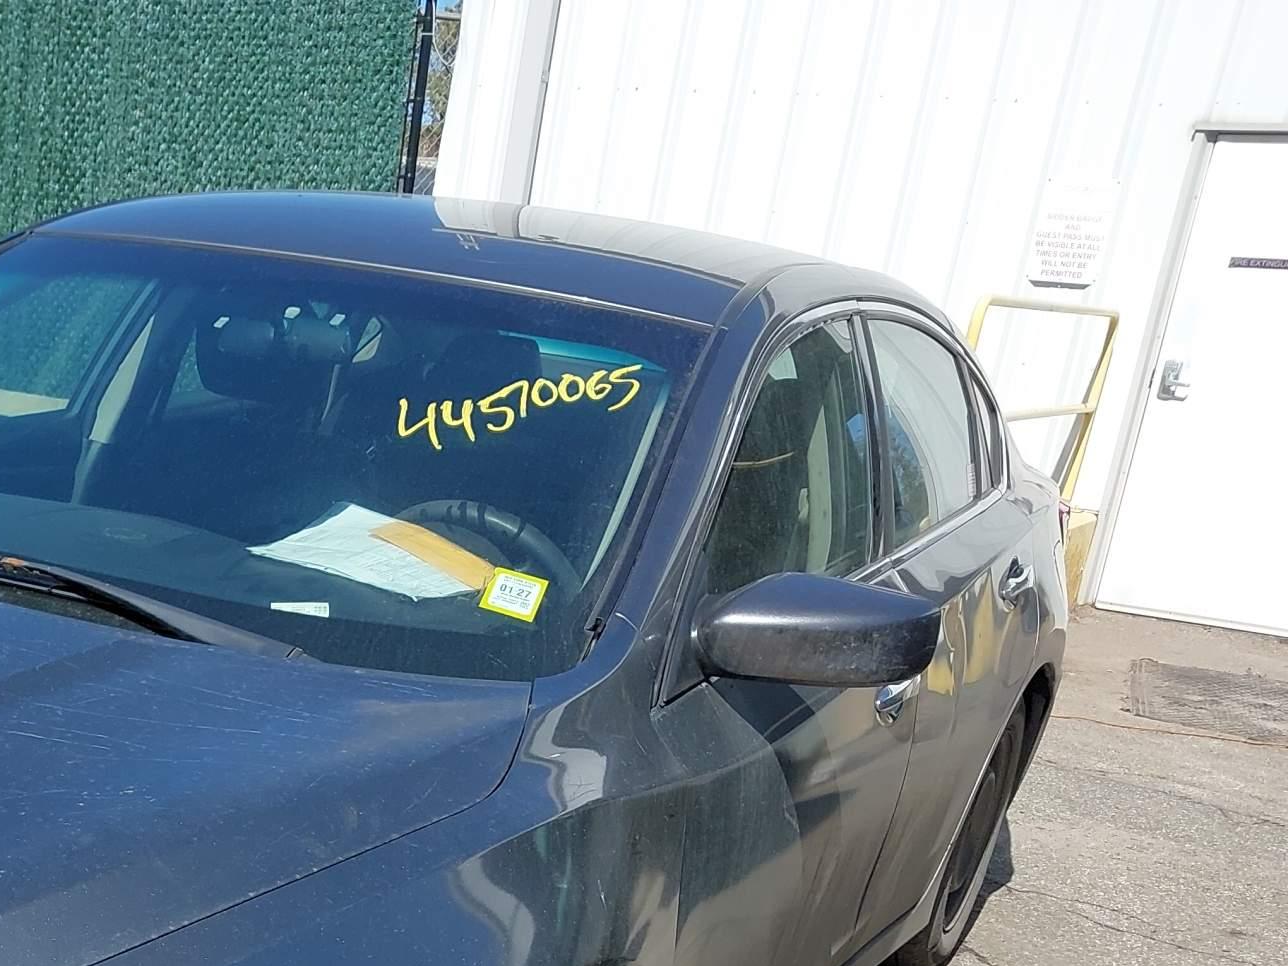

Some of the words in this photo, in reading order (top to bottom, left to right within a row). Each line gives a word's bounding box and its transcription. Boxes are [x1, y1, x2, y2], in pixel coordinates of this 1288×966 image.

[1036, 249, 1058, 258] TIMES
[1058, 251, 1070, 259] OR
[1072, 252, 1097, 261] ENTRY
[1041, 259, 1057, 268] WILL
[1060, 260, 1076, 268] NOT
[1077, 261, 1089, 269] BE
[1040, 268, 1083, 279] PERMITTED
[397, 363, 645, 451] 44570065
